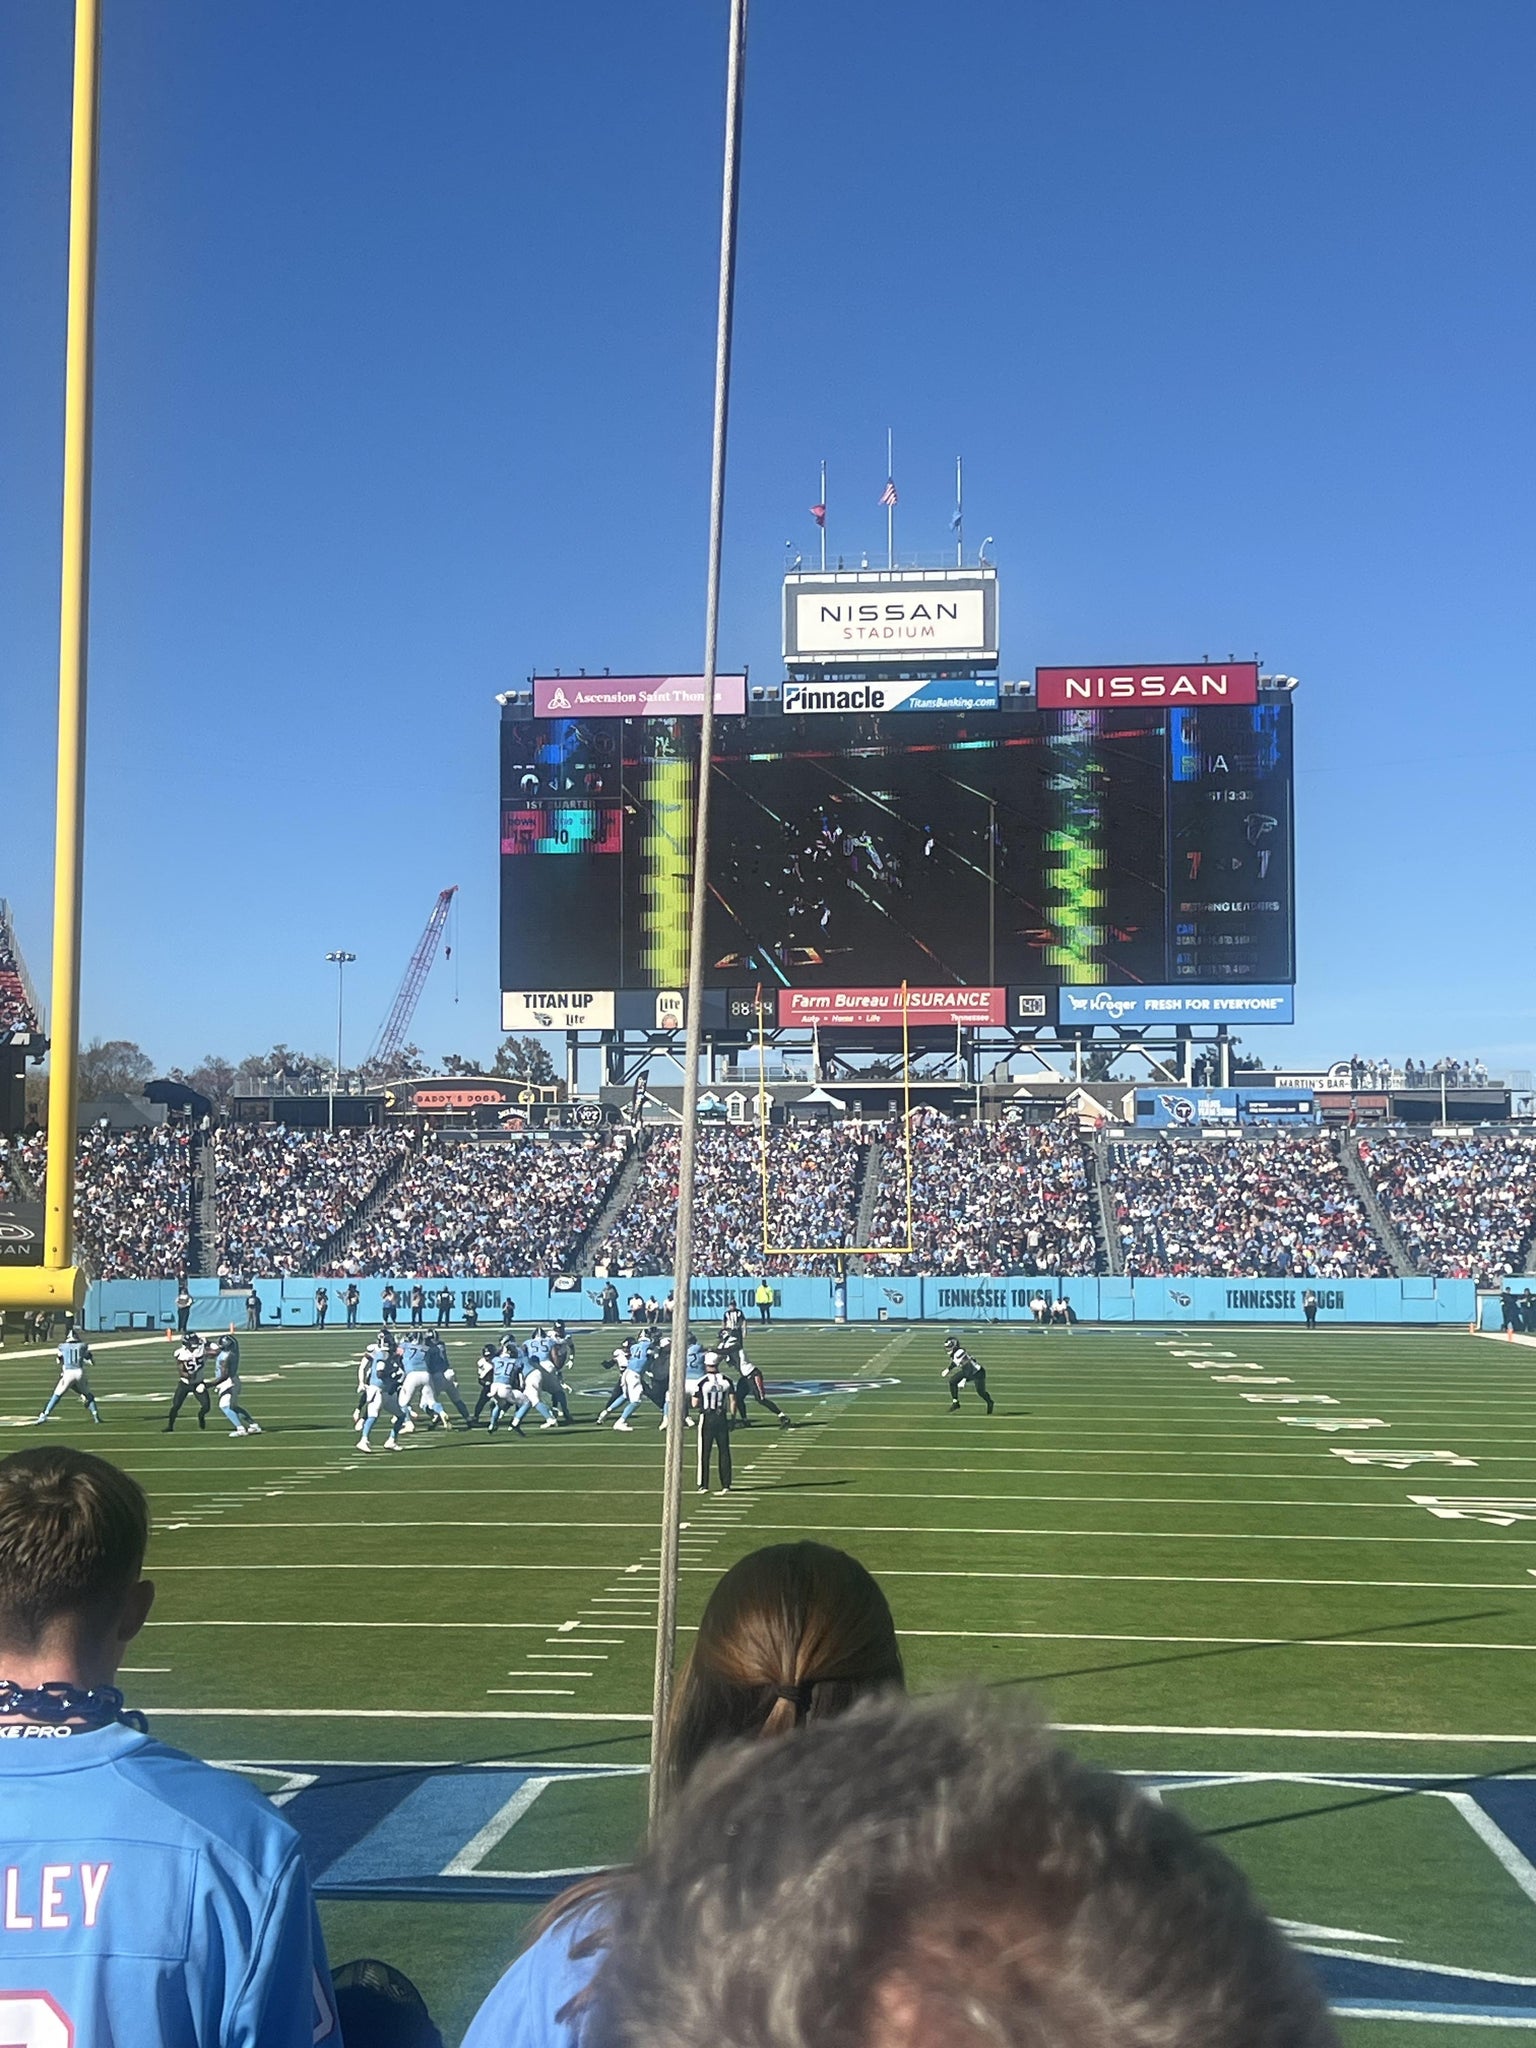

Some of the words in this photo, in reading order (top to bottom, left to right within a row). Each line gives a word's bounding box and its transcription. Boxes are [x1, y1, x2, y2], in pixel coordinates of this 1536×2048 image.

[821, 603, 957, 622] NISSAN
[843, 626, 935, 639] STADIUM
[1065, 675, 1228, 698] NISSAN
[574, 692, 636, 703] Ascension
[639, 691, 671, 702] Saint
[672, 690, 722, 701] Thoms
[786, 685, 885, 709] Pinnacle
[909, 697, 996, 710] TitansBanking.com
[554, 829, 568, 844] 10
[523, 994, 568, 1008] TITAN
[572, 994, 593, 1008] UP
[660, 998, 680, 1012] Lite
[792, 994, 831, 1008] Farm
[835, 993, 889, 1007] Bureau
[893, 992, 991, 1006] INSURANCE
[1090, 992, 1137, 1018] Kroger
[1145, 1000, 1182, 1010] FRESH
[1185, 999, 1210, 1010] FOR
[566, 1013, 585, 1026] Lite
[866, 1014, 881, 1022] Life
[1279, 1078, 1325, 1089] MARTIN'S
[468, 1094, 496, 1102] DOGS
[0, 1245, 31, 1254] AN
[938, 1288, 1006, 1308] TENNESSEE
[1226, 1290, 1296, 1309] TENNESSEE
[1301, 1290, 1344, 1309] TUGH
[531, 1340, 549, 1353] 55
[687, 1353, 699, 1369] 2
[23, 1725, 72, 1739] PRO
[4, 1862, 112, 1931] LEY
